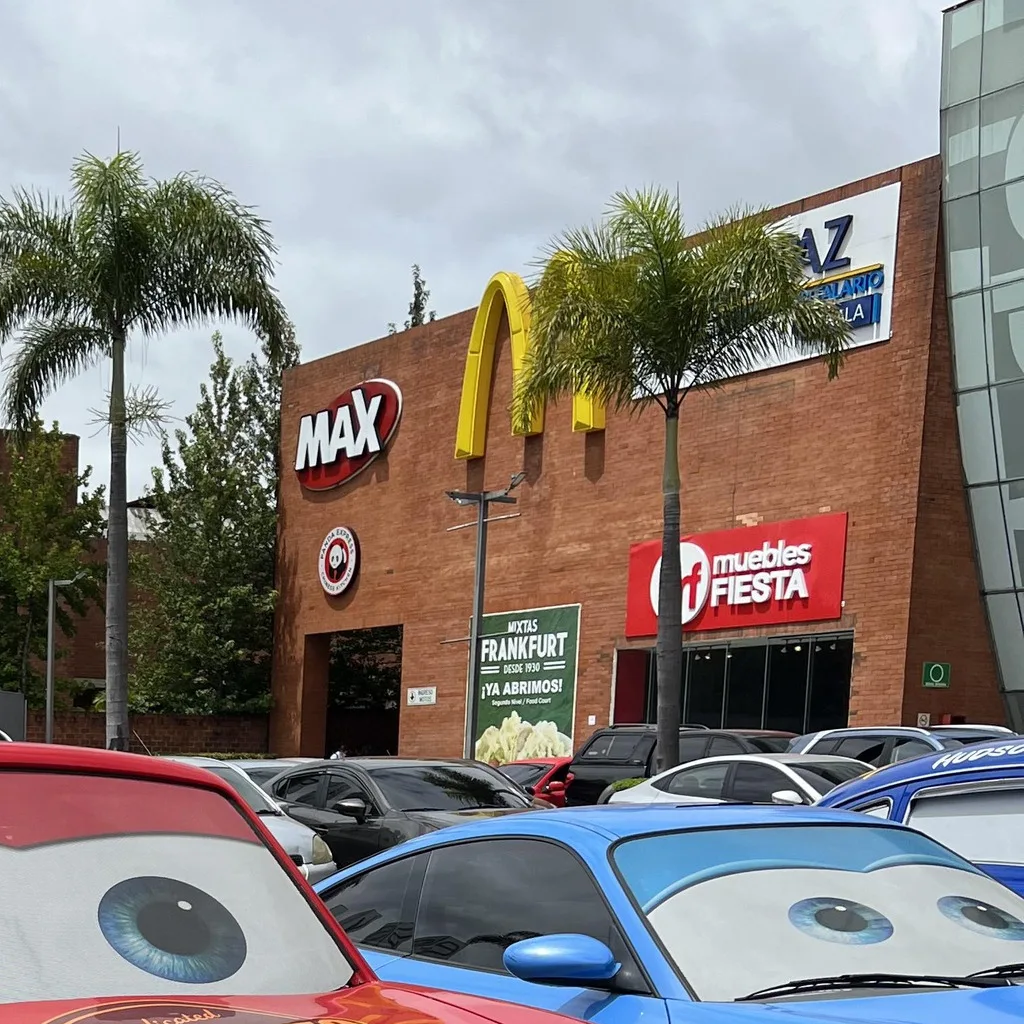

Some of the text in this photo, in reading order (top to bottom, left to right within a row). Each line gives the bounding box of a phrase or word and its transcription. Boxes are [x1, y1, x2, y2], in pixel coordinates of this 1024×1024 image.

[294, 387, 384, 472] MAX
[712, 539, 812, 576] muebles
[710, 567, 810, 608] FIESTA
[507, 618, 539, 634] MIXTAS
[480, 631, 569, 663] FRANKFURT
[503, 662, 541, 675] DESDE 1930
[481, 678, 564, 700] ¡YA ABRIMOS!
